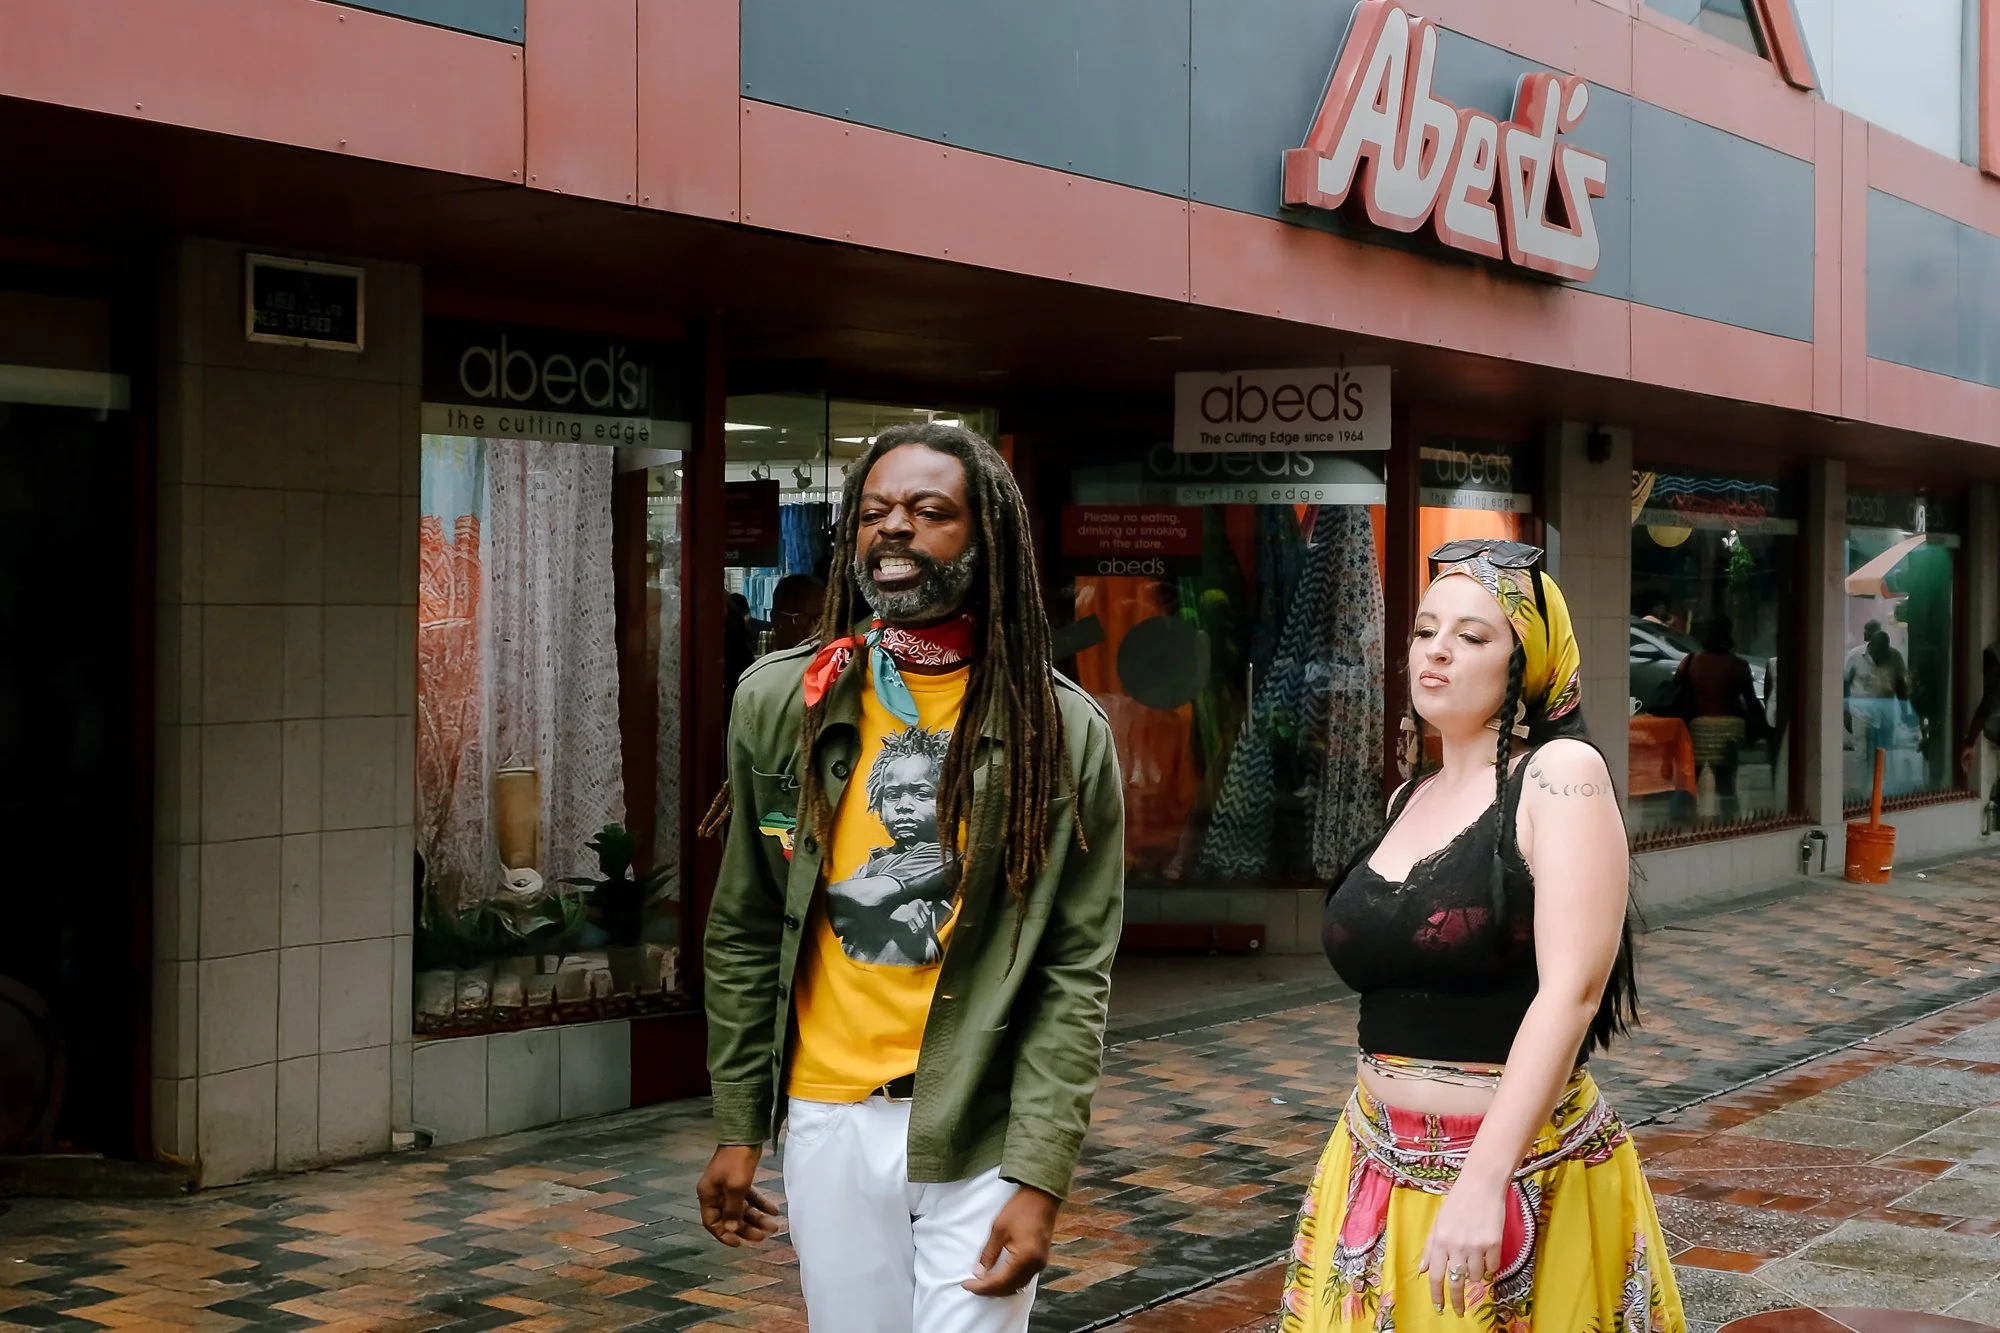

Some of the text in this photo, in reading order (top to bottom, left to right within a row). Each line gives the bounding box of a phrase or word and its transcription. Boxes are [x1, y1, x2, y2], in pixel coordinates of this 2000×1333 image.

[1315, 4, 1608, 272] Abed's
[459, 333, 639, 411] abed's
[1200, 371, 1364, 424] abed's
[447, 408, 649, 445] the cutting edge
[1200, 430, 1364, 446] The Cutting Edge since 1964
[1270, 486, 1325, 502] edge
[1431, 491, 1516, 511] the cutting edge
[1083, 511, 1120, 523] Please
[1122, 513, 1138, 523] no
[1077, 525, 1187, 538] drinking or smoking
[1099, 538, 1165, 549] in the store.
[1097, 556, 1165, 575] abed's
